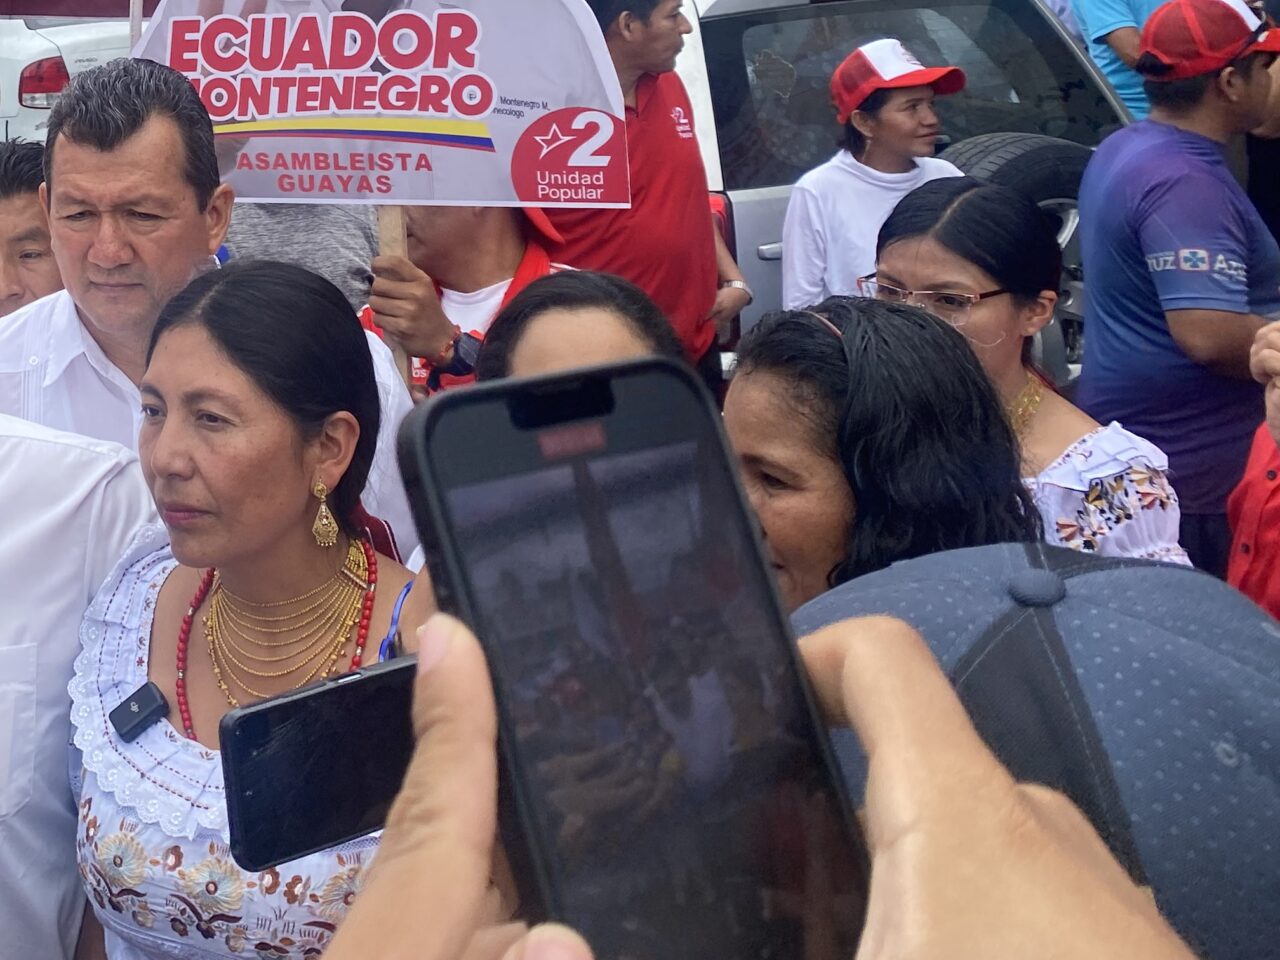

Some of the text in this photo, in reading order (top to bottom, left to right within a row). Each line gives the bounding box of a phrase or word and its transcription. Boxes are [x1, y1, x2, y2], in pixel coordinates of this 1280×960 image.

[169, 12, 479, 73] ECUADOR
[193, 73, 494, 118] ONTENEGRO
[500, 96, 540, 110] Montenegro
[567, 111, 615, 167] 2
[236, 152, 433, 172] ASAMBLEISTA
[277, 174, 393, 194] GUAYAS
[536, 171, 604, 185] Unidad
[538, 186, 604, 202] Popular
